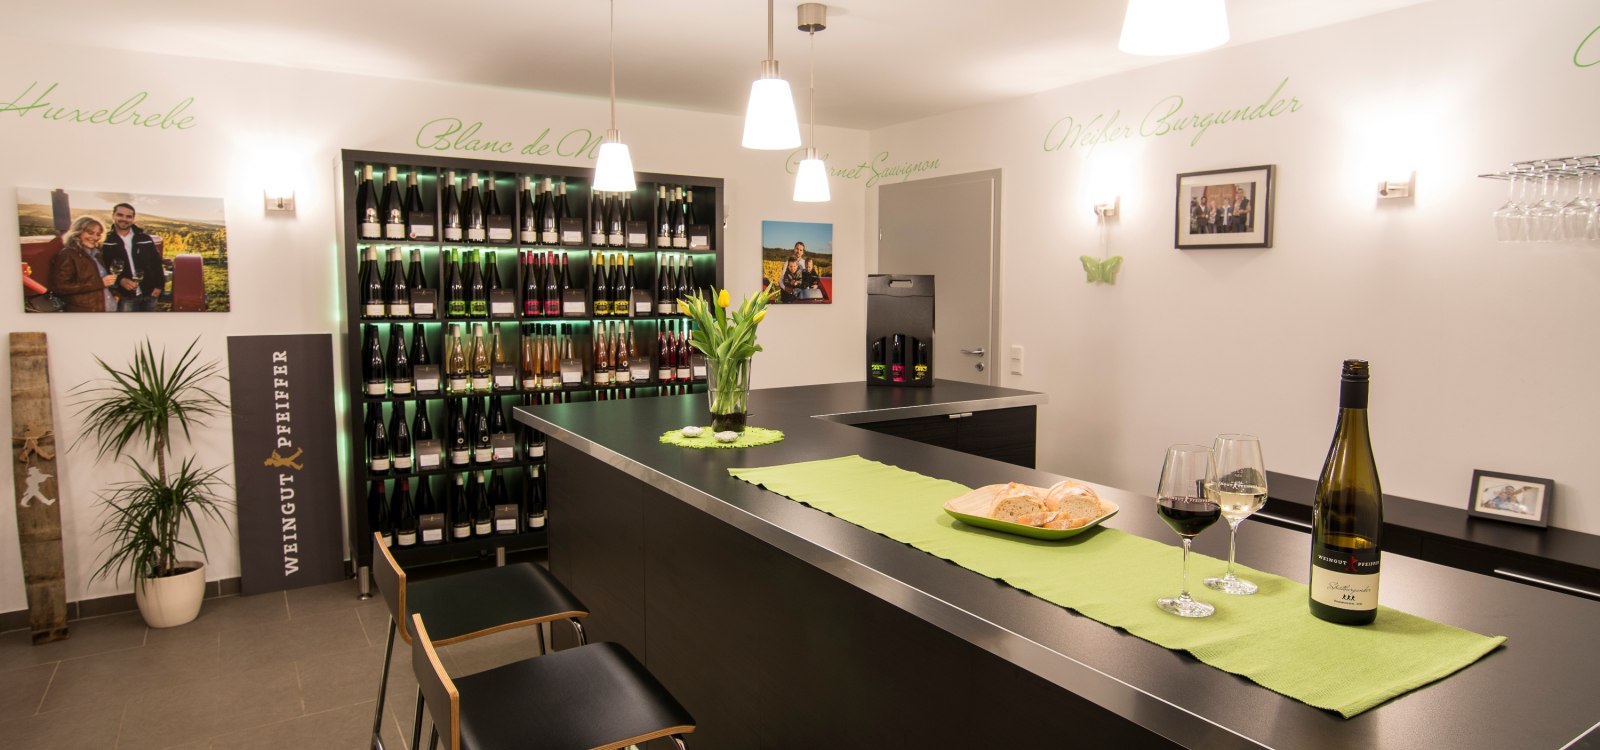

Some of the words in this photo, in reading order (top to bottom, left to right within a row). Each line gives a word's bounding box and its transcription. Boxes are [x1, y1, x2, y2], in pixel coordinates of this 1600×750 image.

[0, 81, 197, 130] Huxelrebe
[1139, 77, 1304, 147] Burgunder
[415, 117, 514, 154] Blanc
[520, 128, 551, 156] de
[556, 128, 603, 160] N
[785, 148, 870, 179] Crnet
[865, 151, 941, 188] Sauvignon
[272, 350, 292, 448] PFEIFFER
[279, 473, 299, 576] WEINGUT
[1318, 555, 1347, 566] WEINGUT
